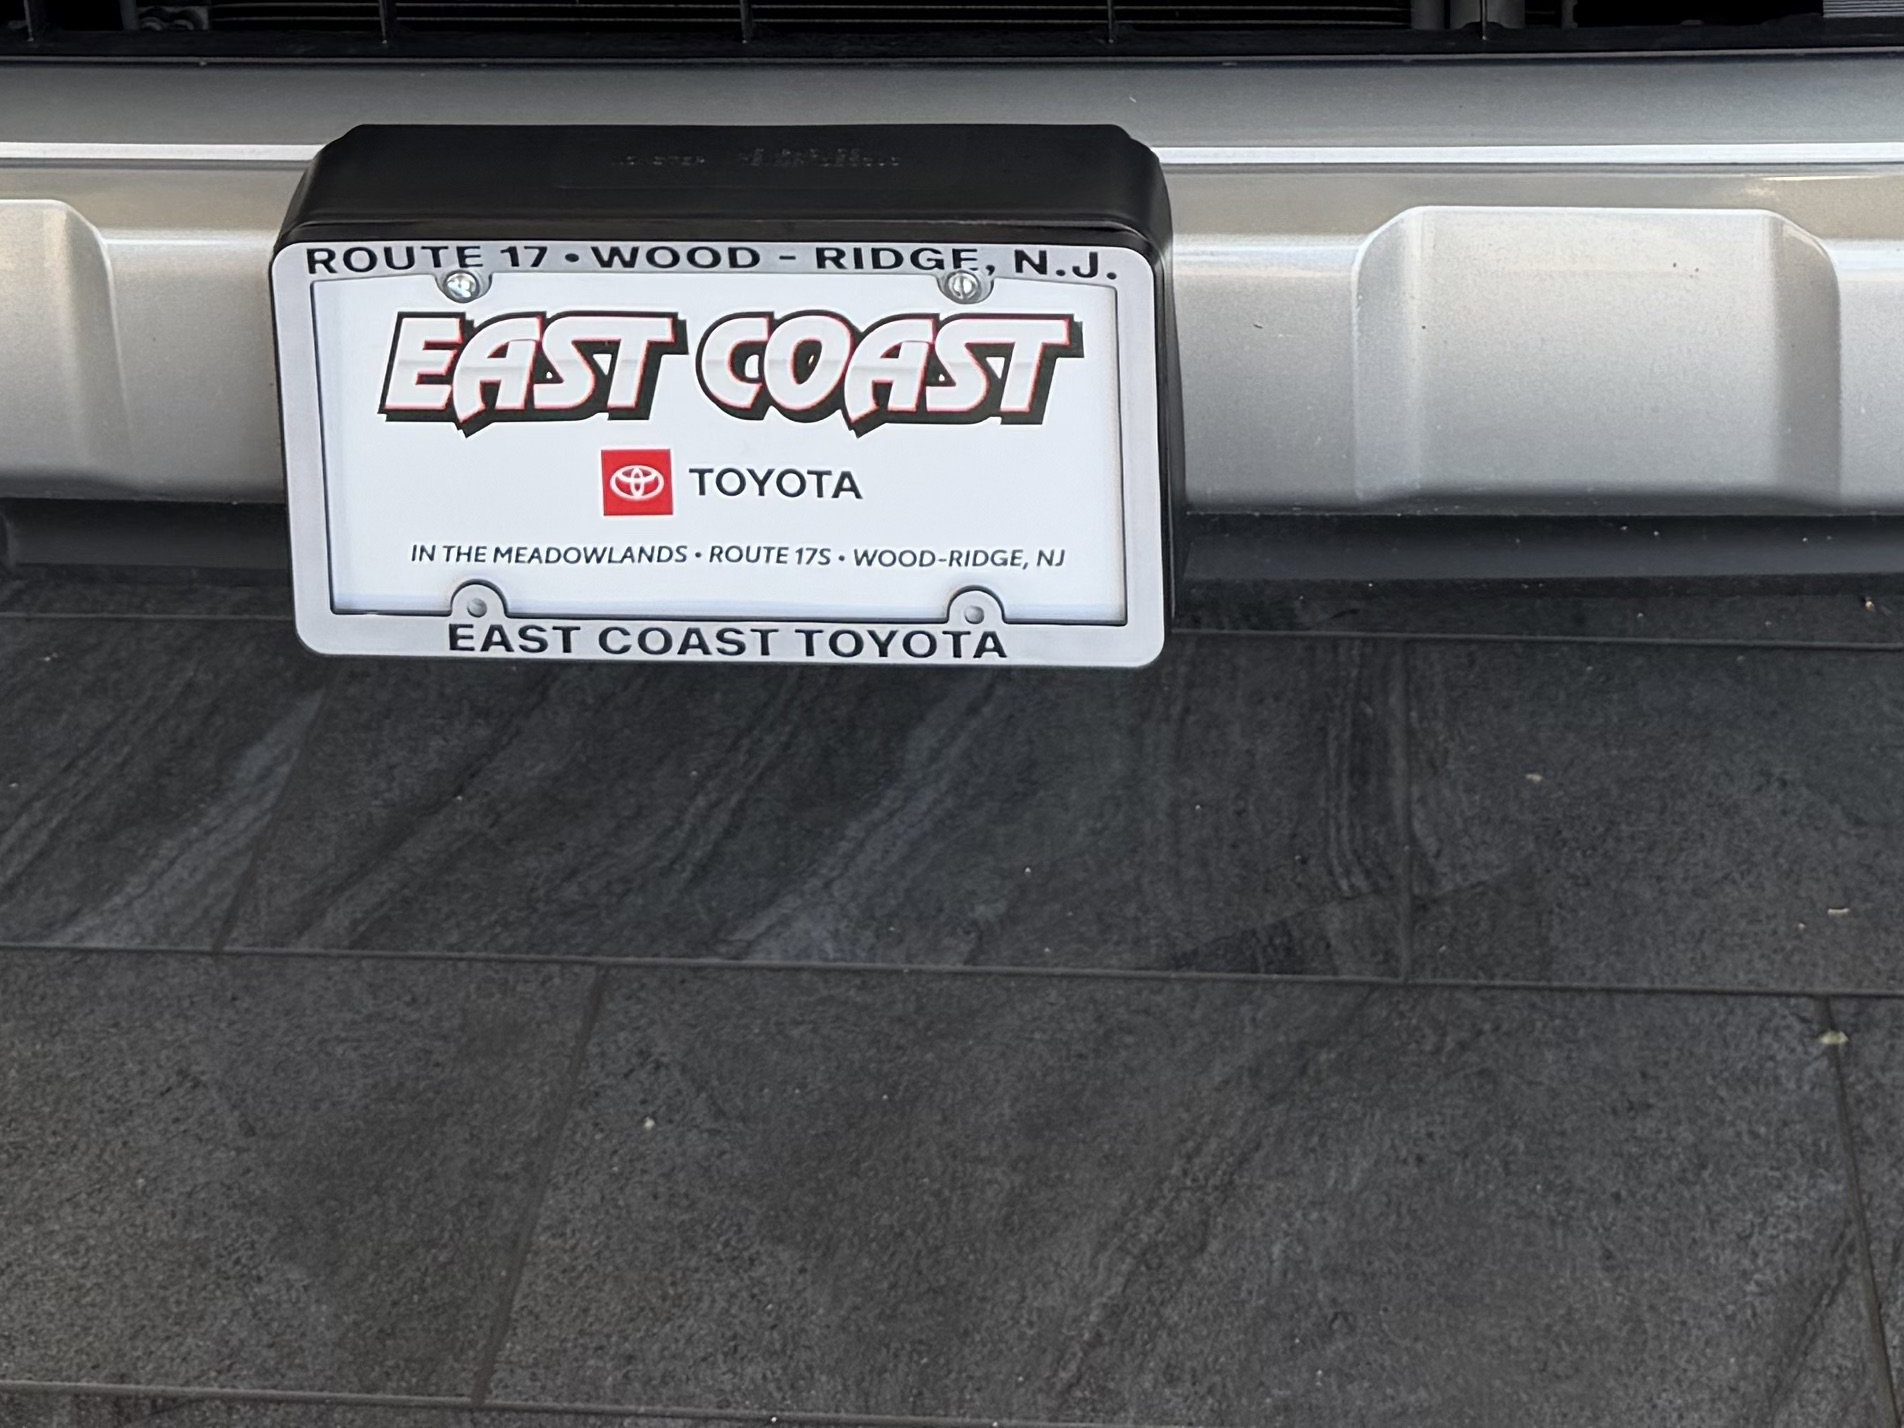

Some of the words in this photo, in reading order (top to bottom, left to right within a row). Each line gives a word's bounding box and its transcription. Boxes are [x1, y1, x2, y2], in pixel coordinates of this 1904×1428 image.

[306, 246, 484, 274] ROUTE
[499, 246, 549, 269] 17
[590, 246, 761, 270] WOOD
[815, 247, 995, 275] RIDGE,
[1014, 249, 1118, 281] N.J.
[377, 311, 690, 438] EAST
[696, 311, 1085, 438] COAST
[689, 467, 863, 501] TOYOTA
[411, 544, 436, 562] IN
[443, 545, 487, 563] THE
[493, 545, 688, 564] MEADOWLANDS
[709, 546, 789, 565] ROUTE
[795, 547, 831, 566] 17S
[853, 549, 1030, 570] WOOD-RIDGE,
[1036, 549, 1066, 567] NJ
[448, 624, 581, 654] EAST
[598, 626, 779, 656] COAST
[795, 629, 1008, 658] TOYOTA
